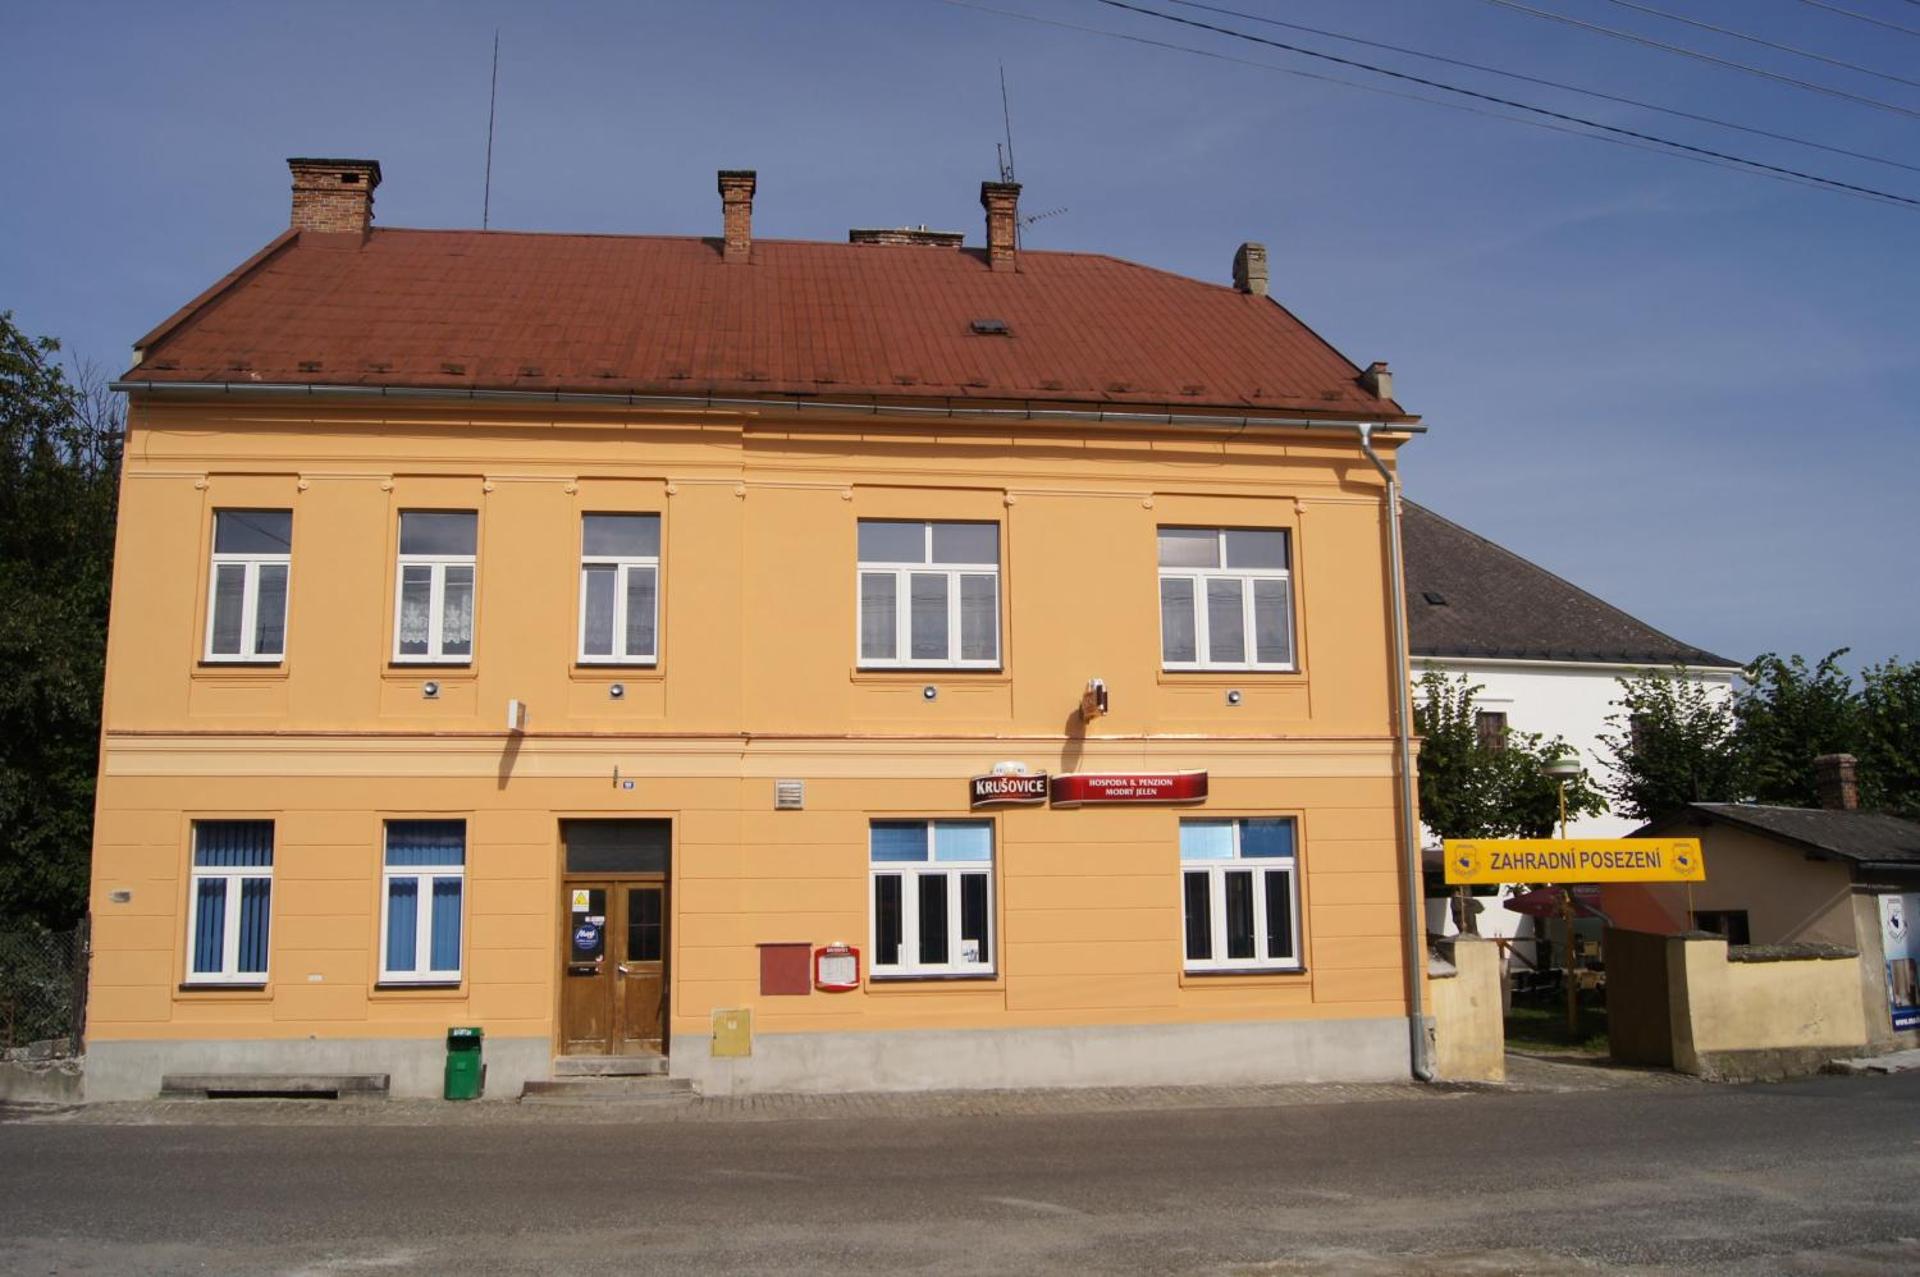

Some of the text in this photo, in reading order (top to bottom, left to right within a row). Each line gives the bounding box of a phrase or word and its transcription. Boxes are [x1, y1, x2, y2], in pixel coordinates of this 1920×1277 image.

[976, 777, 1044, 795] KRUŠOVICE
[1089, 778, 1128, 787] HOSPODA
[1138, 778, 1173, 787] PENZION
[1136, 787, 1158, 796] JELEN
[1490, 848, 1662, 870] ZAHRADNÍ POSEZENÍ
